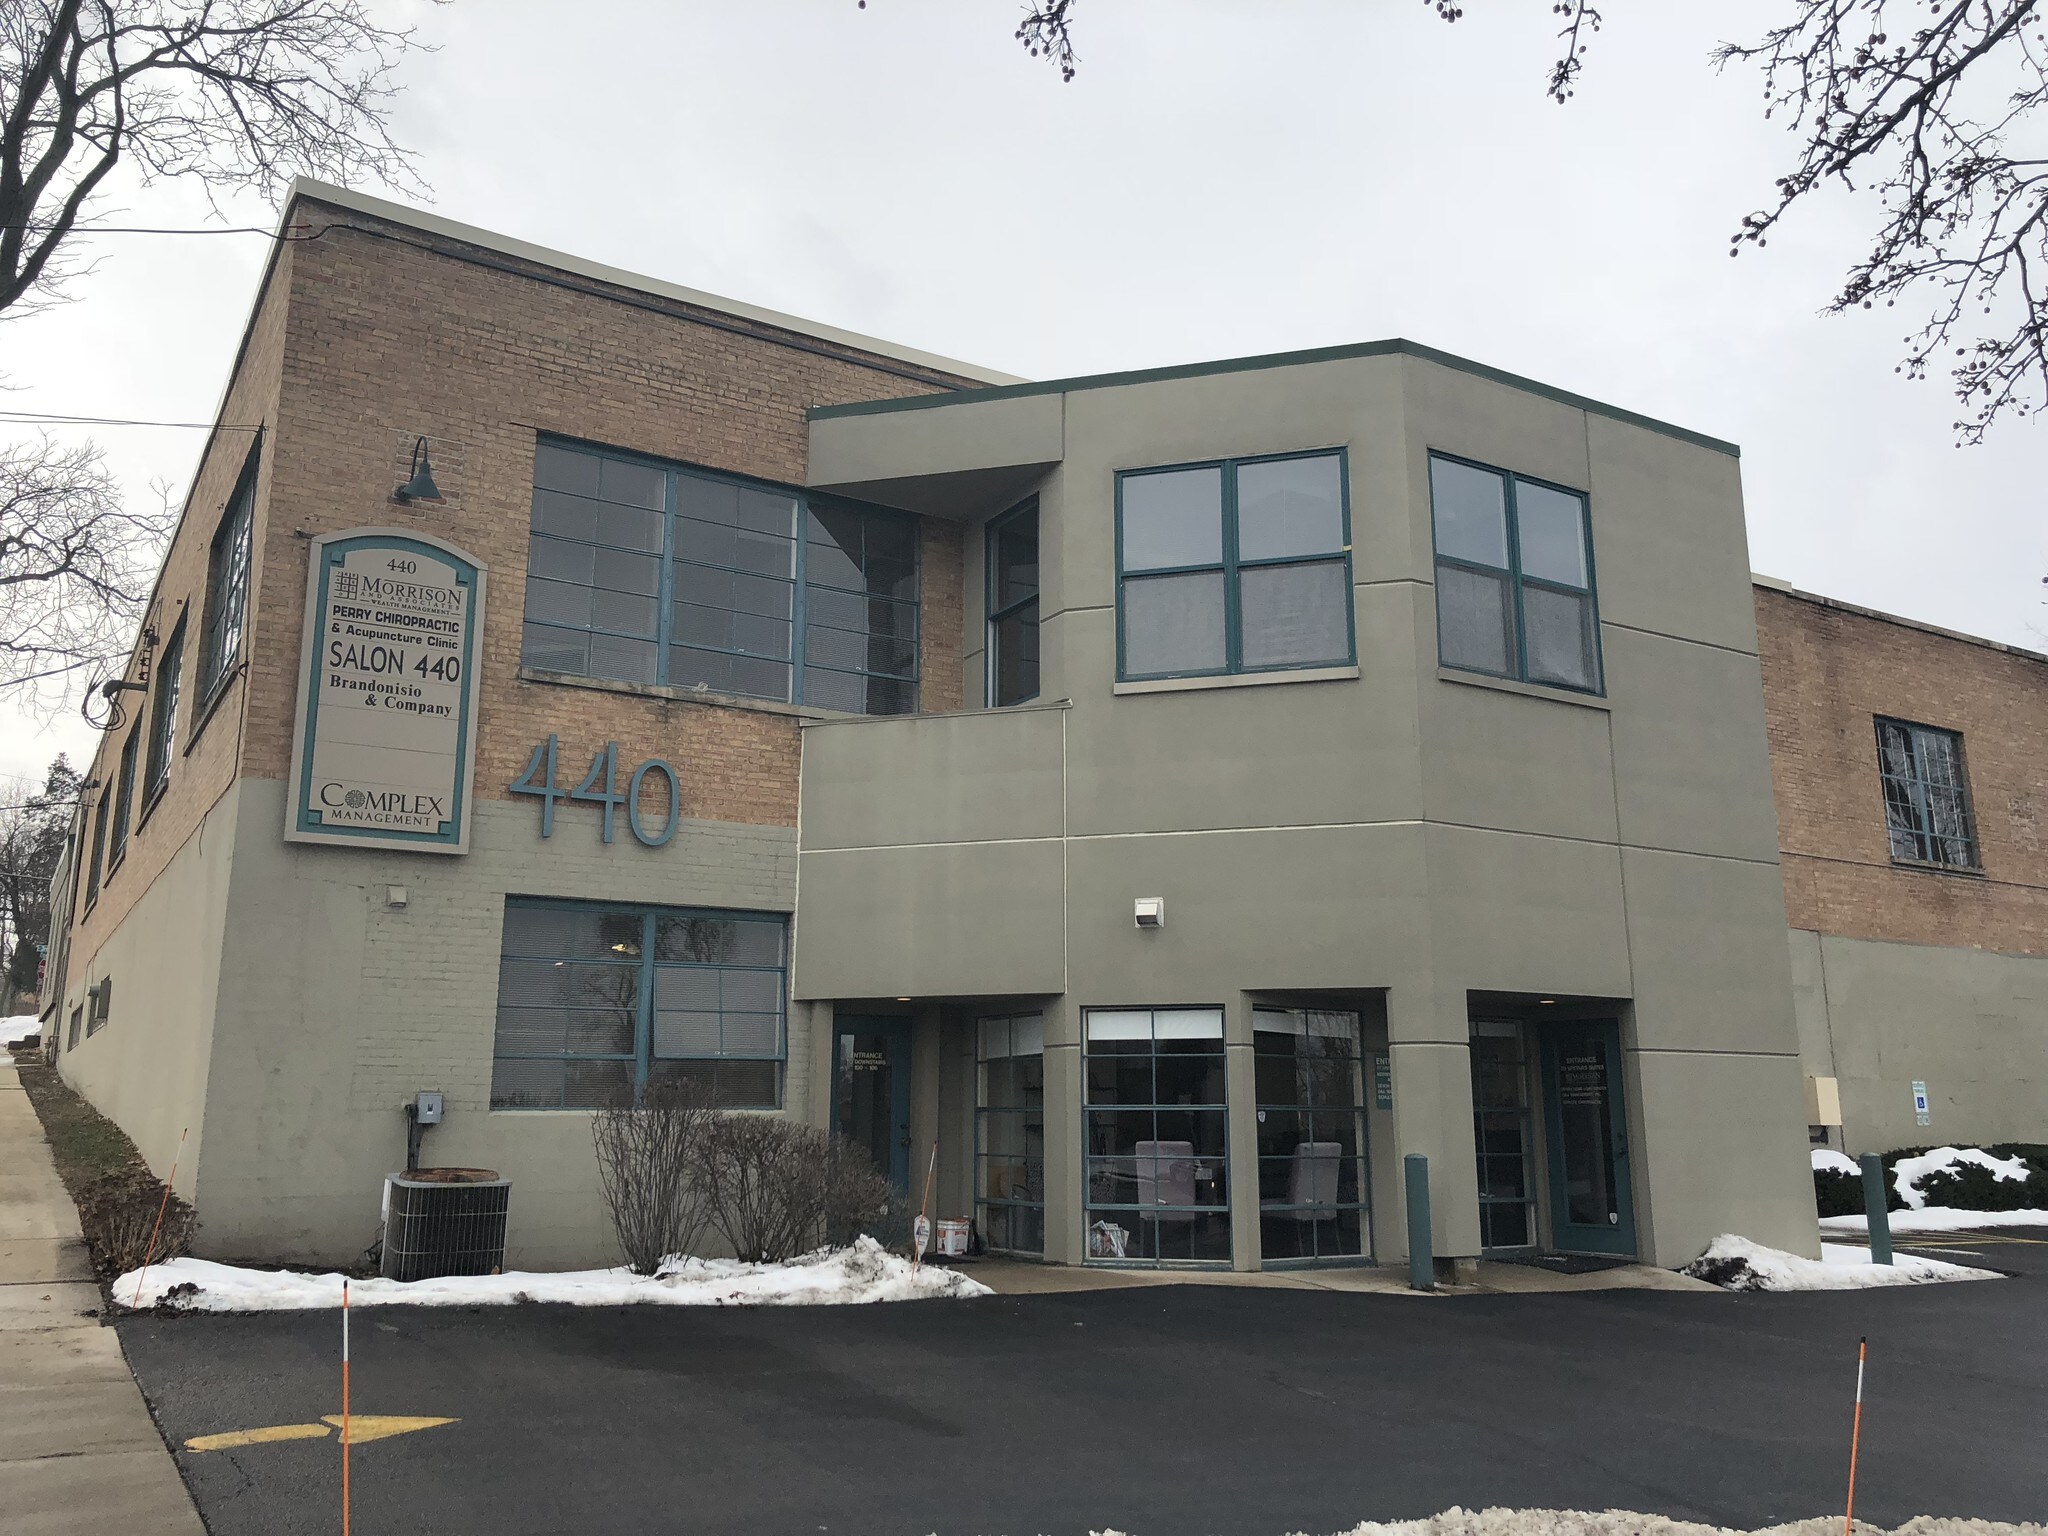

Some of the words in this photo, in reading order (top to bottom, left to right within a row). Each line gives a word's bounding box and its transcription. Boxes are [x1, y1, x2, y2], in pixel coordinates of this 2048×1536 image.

[387, 558, 417, 575] 440
[360, 591, 382, 599] AND
[390, 595, 460, 611] ASSOCIATES
[361, 576, 462, 605] MORRISON
[333, 604, 372, 620] PERRY
[375, 611, 460, 633] CHIROPRACTIC
[371, 599, 400, 608] WEALTH
[401, 603, 450, 615] MANAGEMENT
[331, 622, 340, 633] &
[345, 624, 422, 645] Acupuncture
[427, 636, 458, 650] Clinic
[329, 640, 404, 675] SALON
[413, 654, 460, 682] 440
[330, 674, 422, 697] Brandonisio
[365, 693, 377, 706] &
[384, 695, 452, 717] Company
[509, 734, 680, 847] 440
[331, 809, 432, 826] MANAGEMENT
